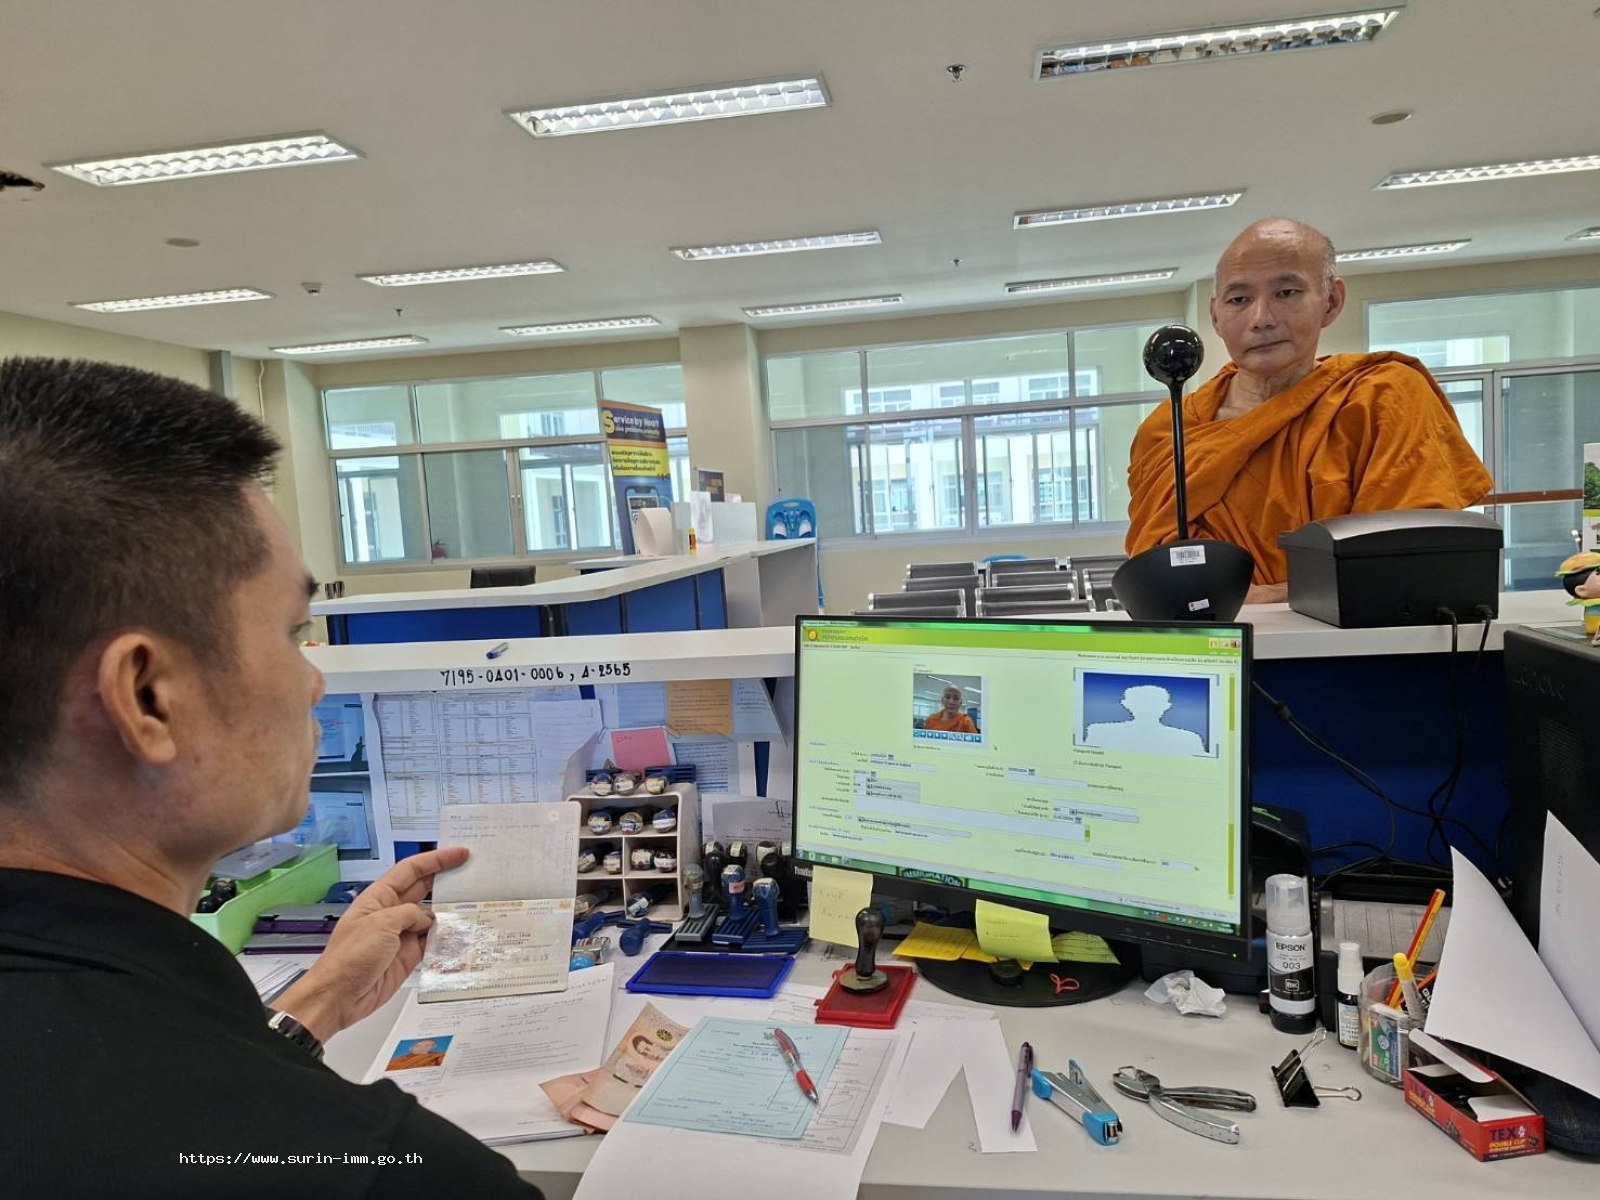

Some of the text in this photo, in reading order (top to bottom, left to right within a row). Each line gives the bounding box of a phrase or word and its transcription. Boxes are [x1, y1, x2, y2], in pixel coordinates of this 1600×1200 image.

[602, 410, 634, 433] Service
[635, 416, 643, 427] by
[1275, 942, 1306, 952] EPSON
[1282, 961, 1301, 970] 003
[1490, 1127, 1517, 1141] TEX
